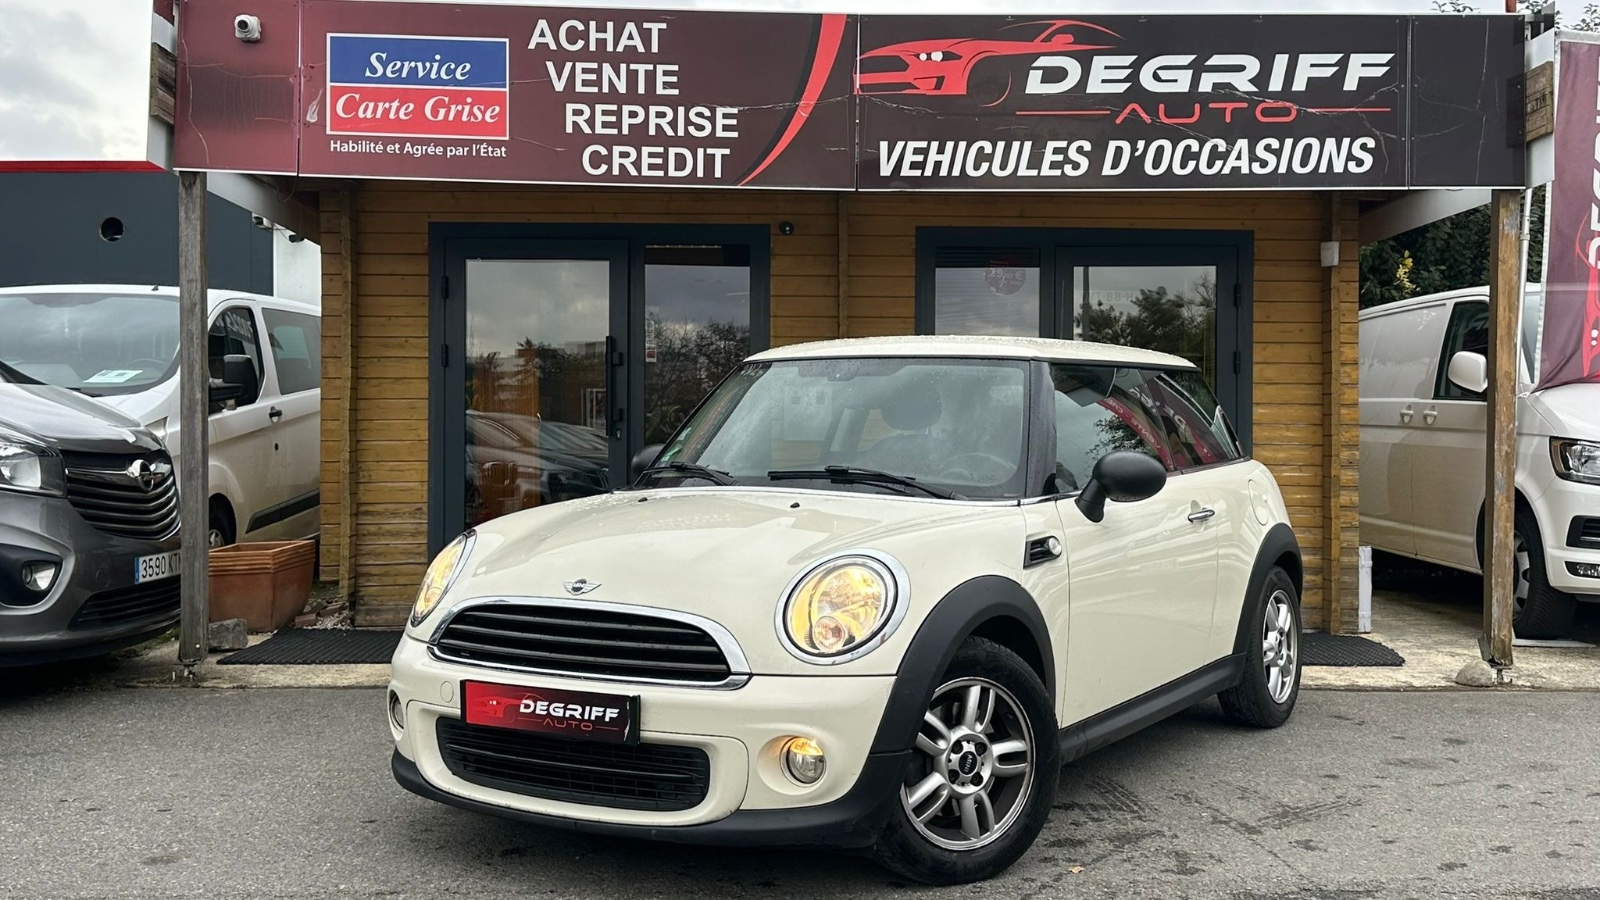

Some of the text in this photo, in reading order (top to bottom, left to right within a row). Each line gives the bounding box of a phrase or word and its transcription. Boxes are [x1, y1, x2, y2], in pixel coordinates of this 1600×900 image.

[528, 20, 667, 53] ACHAT
[364, 52, 471, 80] Service
[545, 61, 680, 96] VENTE
[1024, 53, 1393, 94] DEGRIFF
[335, 93, 501, 123] Carte Grise
[565, 102, 739, 138] REPRISE
[1115, 101, 1298, 125] AUTO
[330, 139, 384, 154] Habilité
[386, 142, 401, 154] et
[402, 141, 444, 158] Agrée
[446, 145, 470, 159] par
[582, 144, 731, 178] CREDIT
[879, 137, 1376, 177] VEHICULES D'OCCASIONS
[141, 555, 167, 579] 3590
[519, 699, 620, 723] DEGRIFF
[543, 718, 593, 731] AUTO
